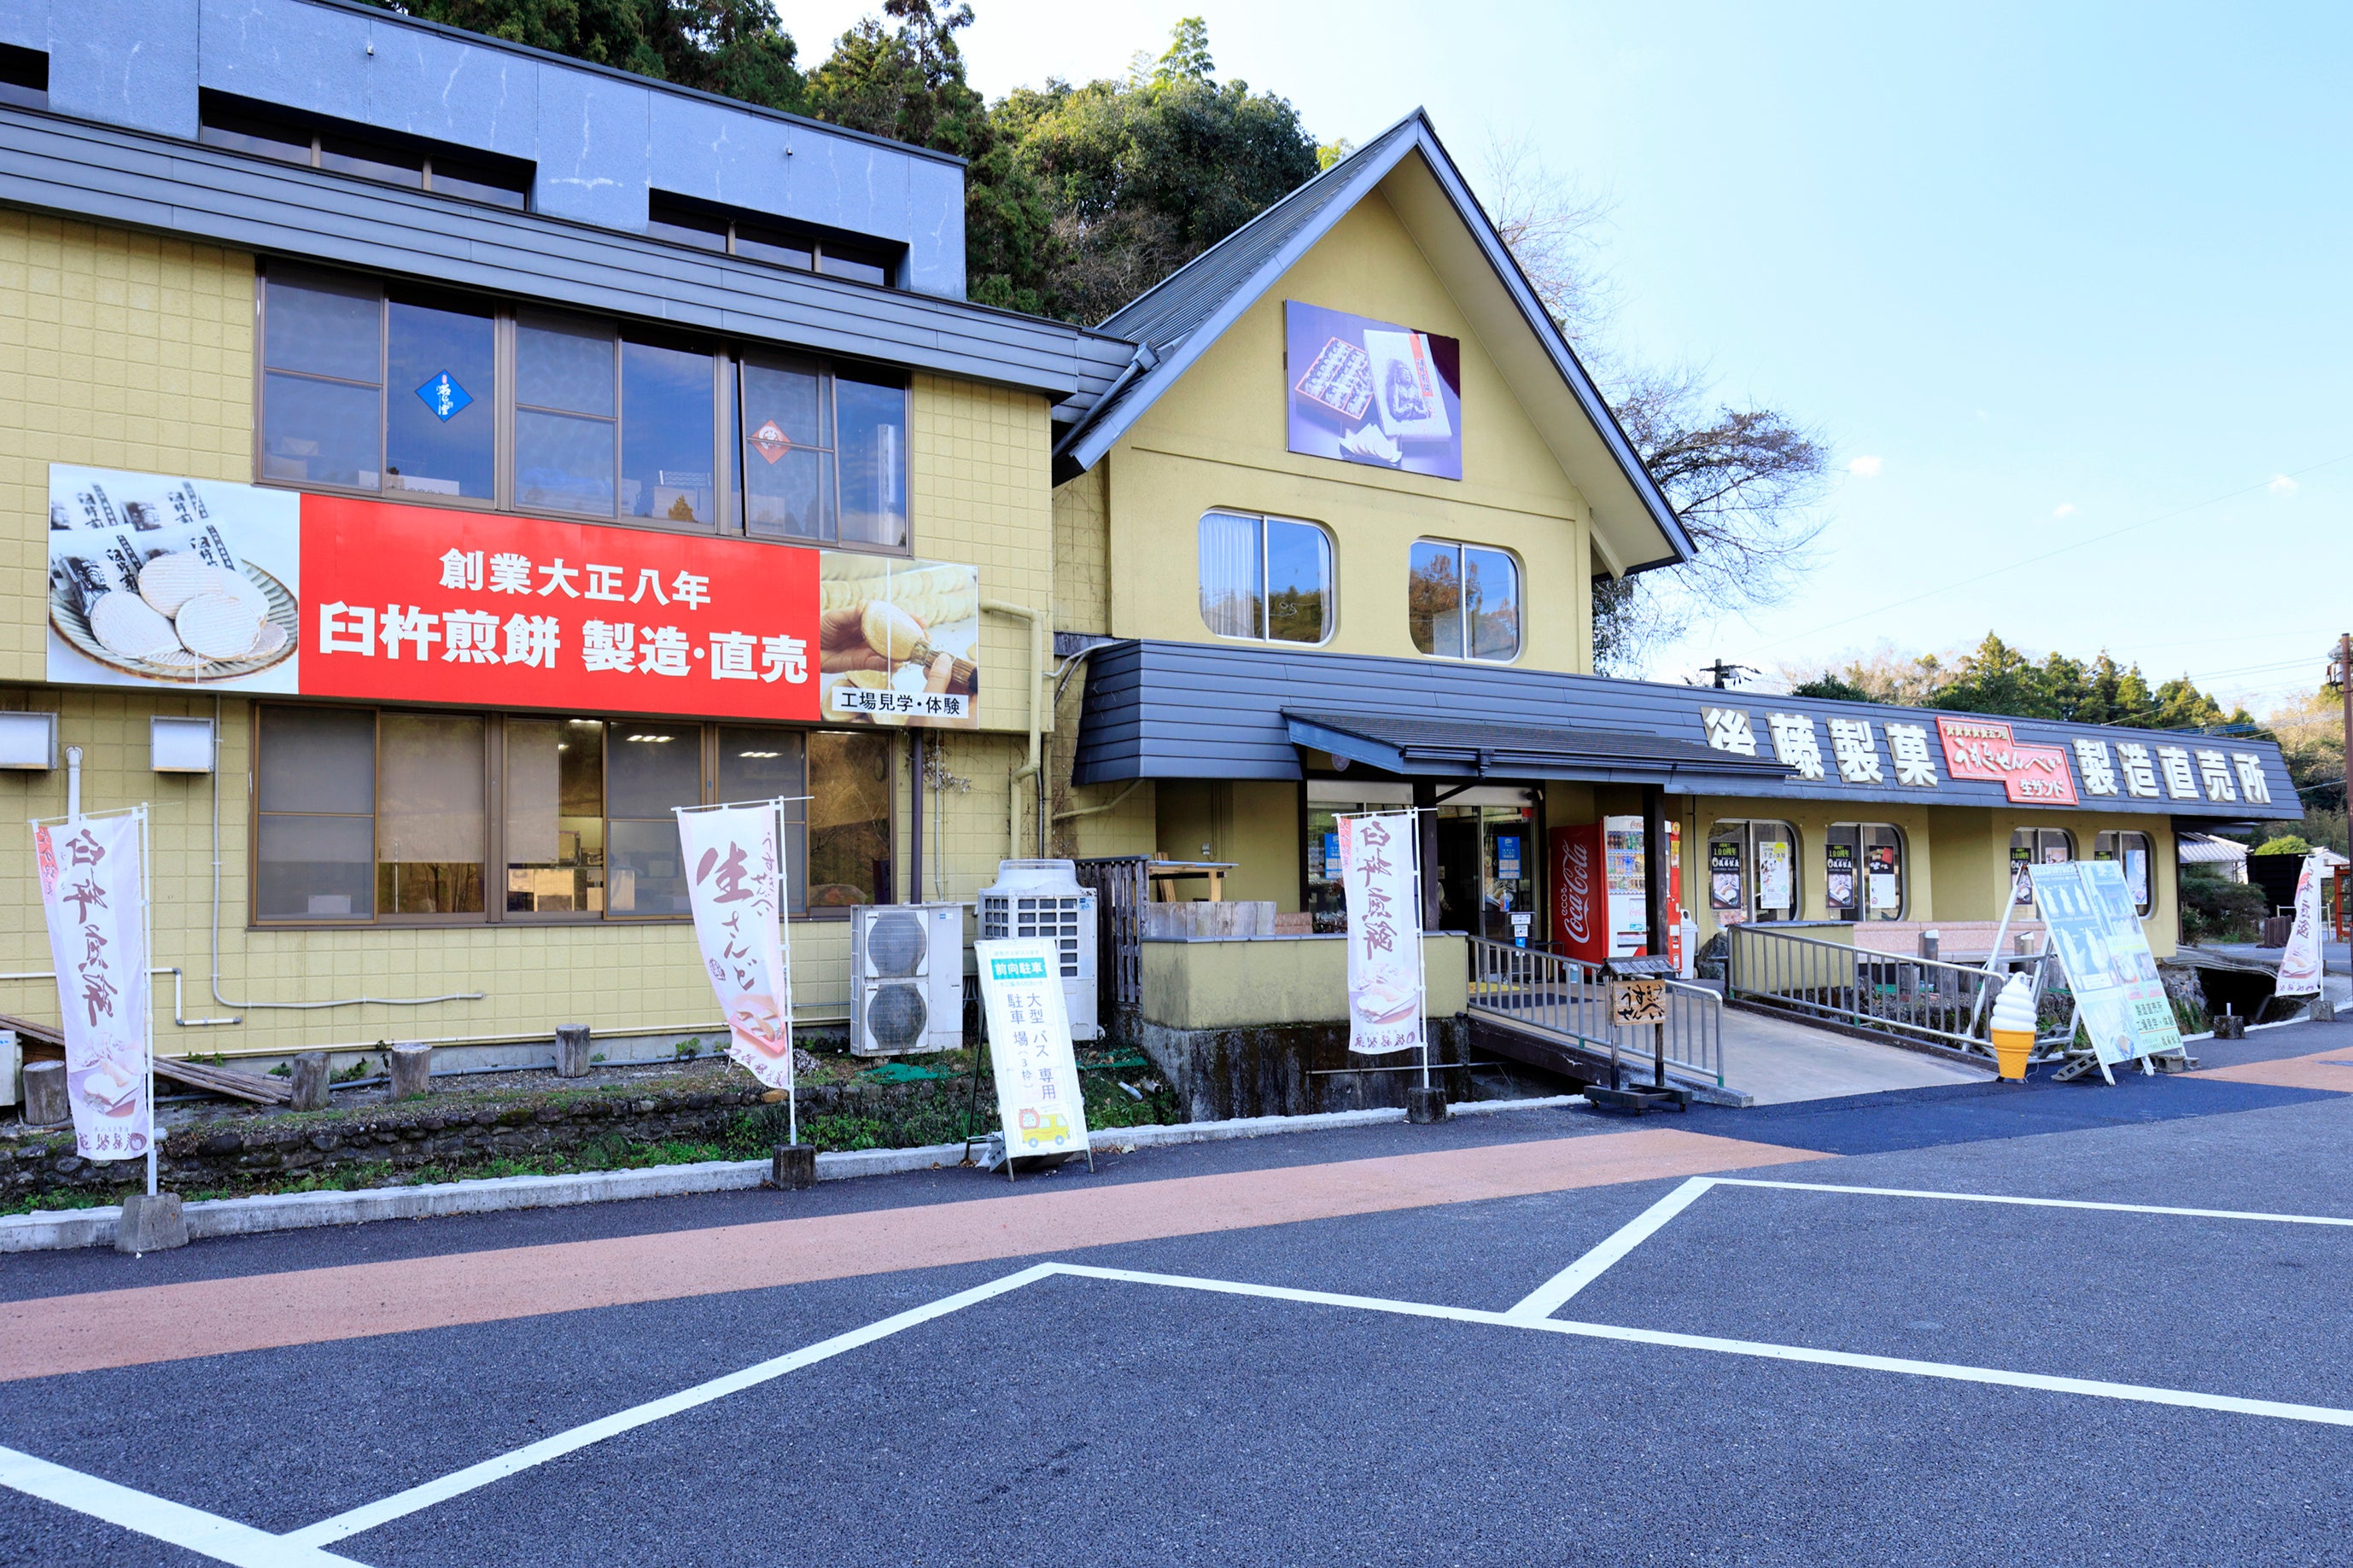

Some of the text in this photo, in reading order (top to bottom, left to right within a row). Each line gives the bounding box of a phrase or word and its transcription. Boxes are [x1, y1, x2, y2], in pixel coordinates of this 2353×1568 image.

[439, 547, 711, 611] 創業大正八年
[318, 600, 809, 685] 臼杵煎餅 製造・直売
[840, 691, 961, 716] 工場見学・体験
[1704, 708, 1939, 786] 後藤製菓
[2072, 738, 2272, 804] 製造直売所
[2019, 778, 2065, 798] 生サンド
[1562, 839, 1590, 944] Coca-Cola
[995, 961, 1043, 976] 前向駐車
